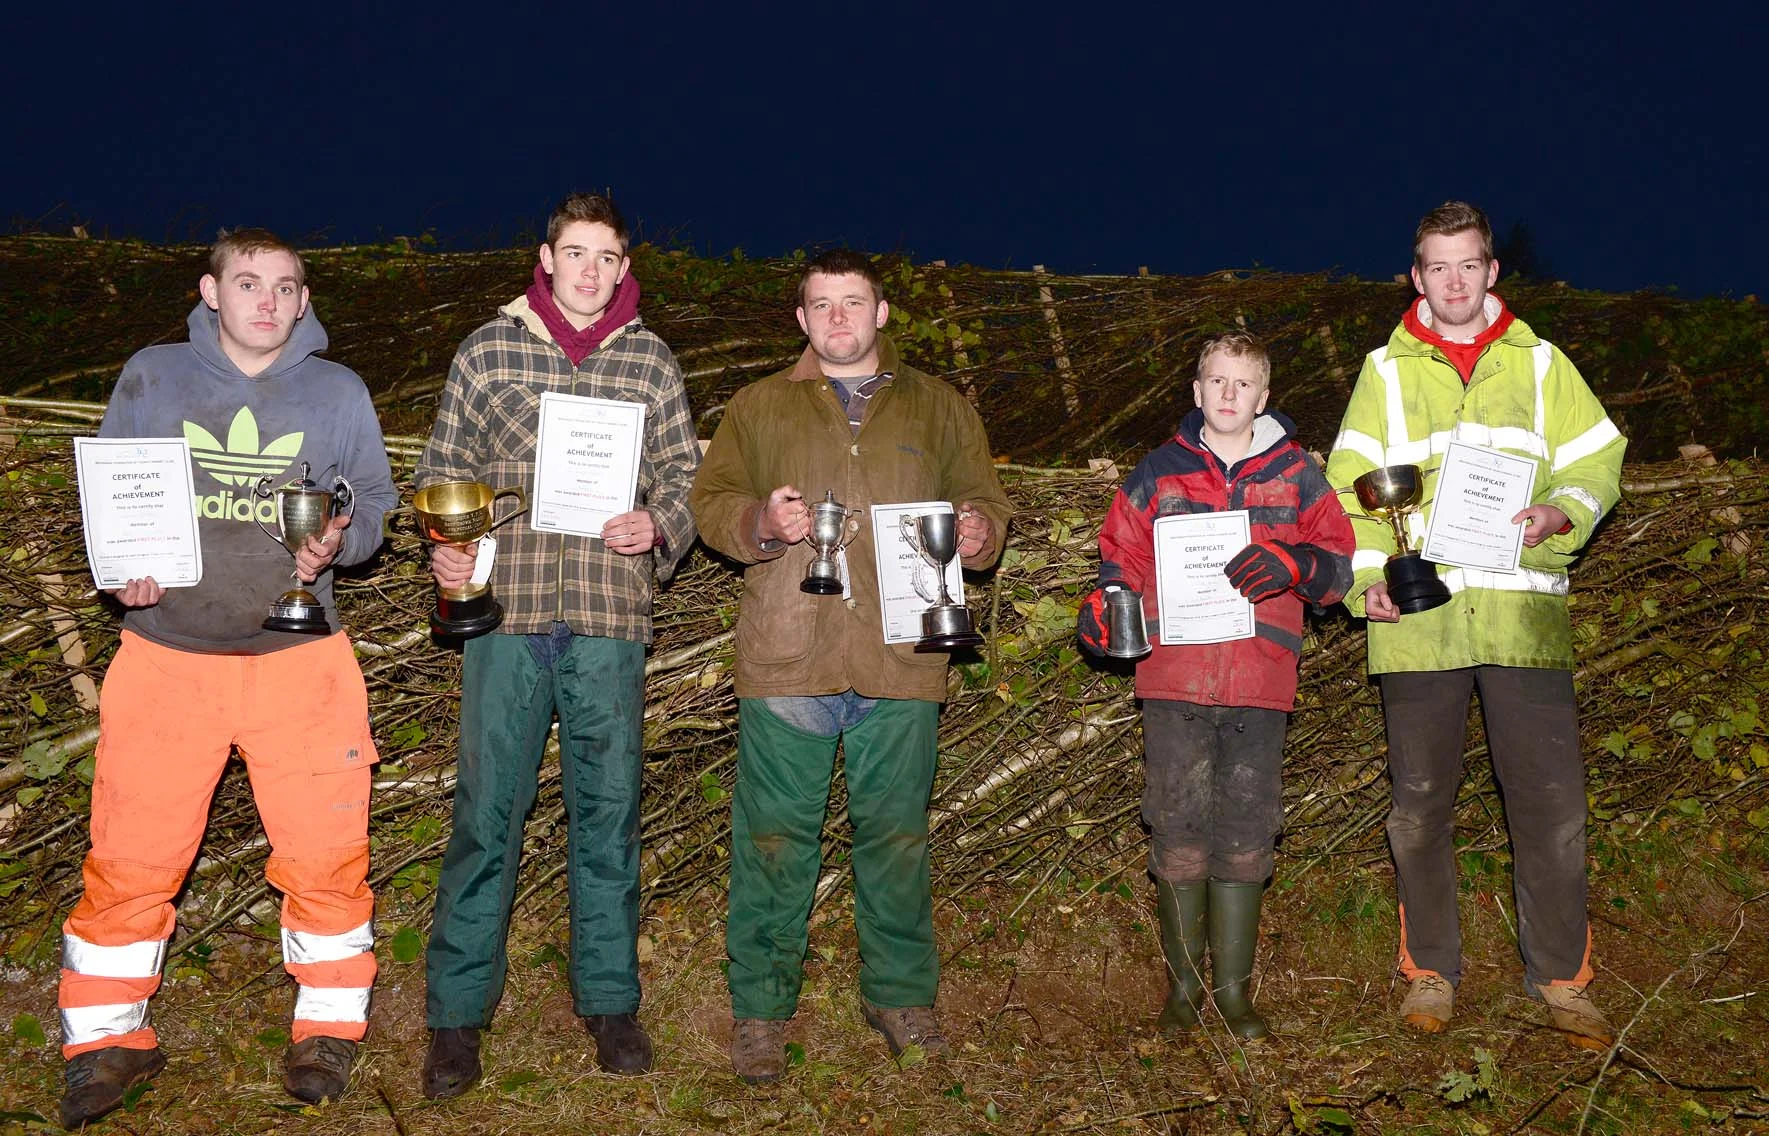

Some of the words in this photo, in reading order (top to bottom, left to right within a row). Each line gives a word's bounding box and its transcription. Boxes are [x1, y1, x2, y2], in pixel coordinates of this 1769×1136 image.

[571, 431, 612, 440] CERTIFICATE
[567, 449, 612, 458] ACHIEVEMENT
[1469, 473, 1506, 488] CERTIFICATE
[113, 491, 165, 500] ACHIEVEMENT
[1464, 489, 1505, 503] ACHIEVEMENT
[194, 490, 277, 523] dida
[1184, 561, 1227, 569] ACHIEVEMENT
